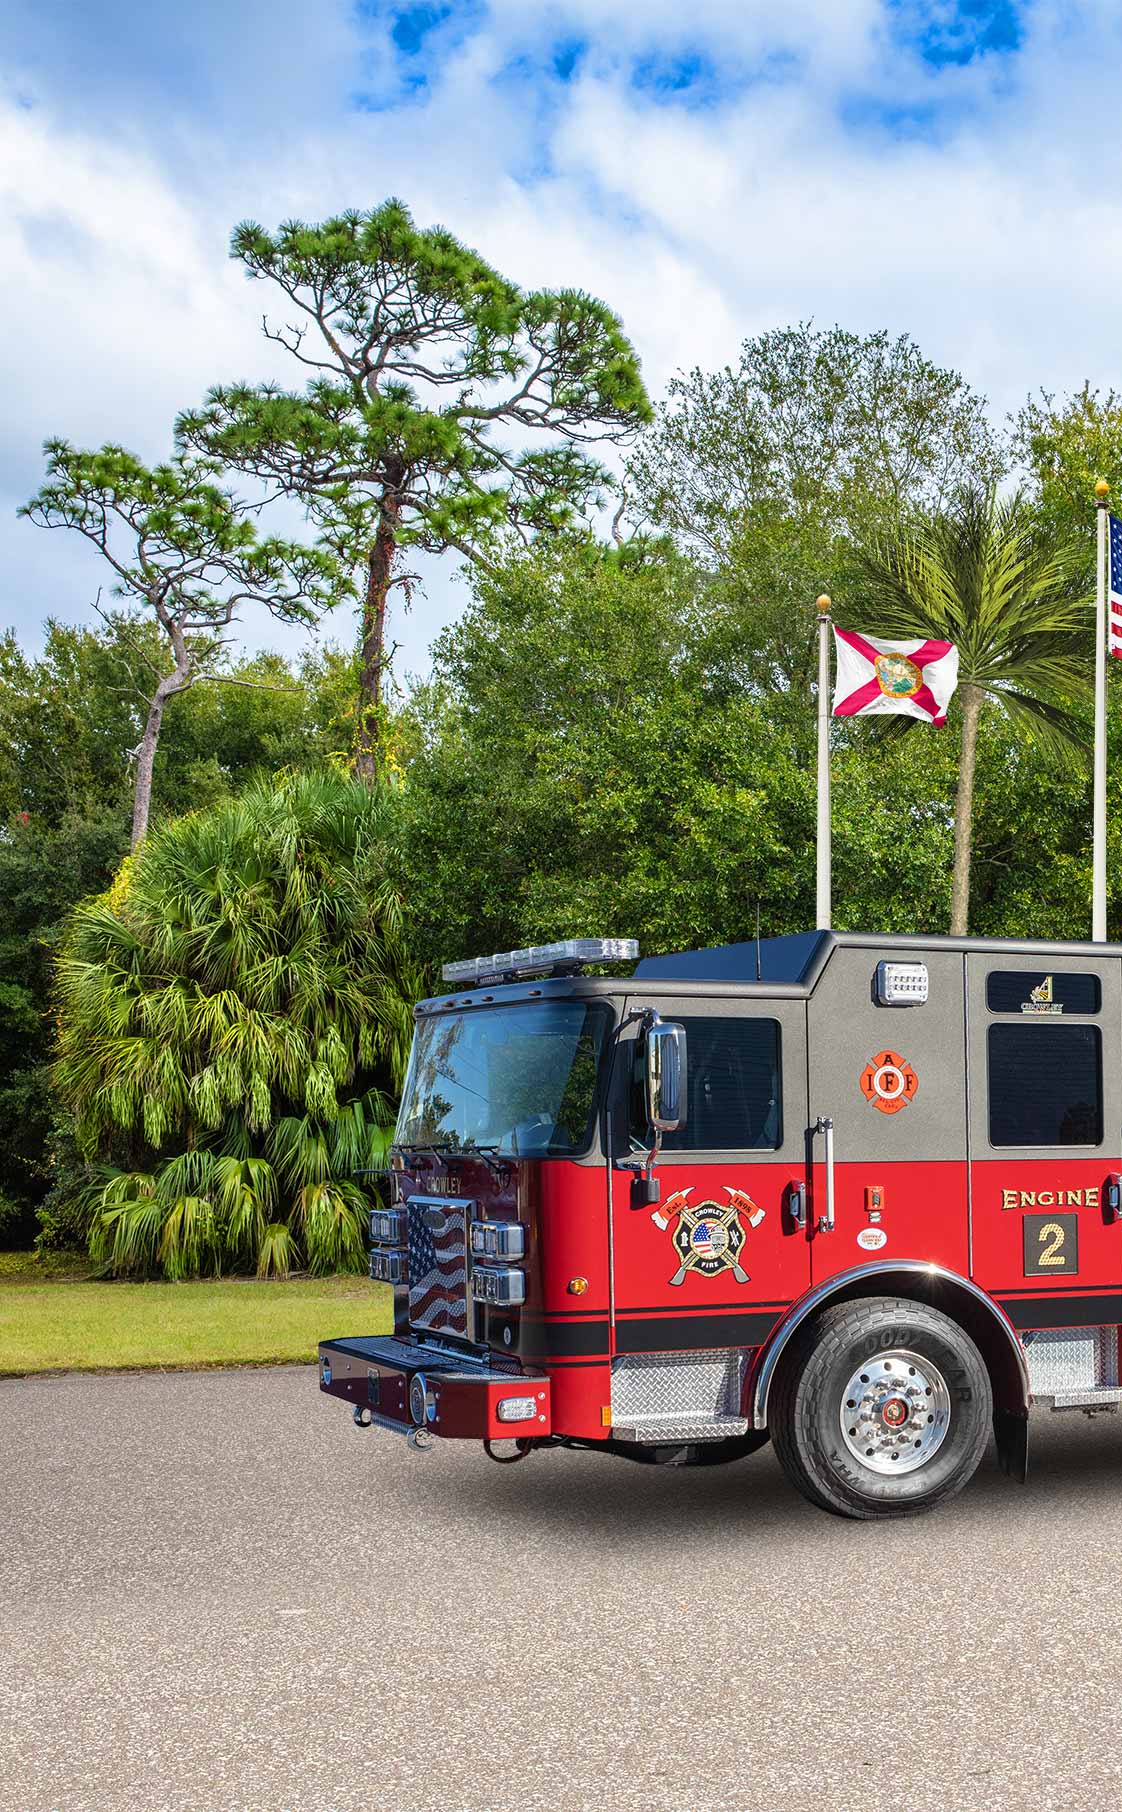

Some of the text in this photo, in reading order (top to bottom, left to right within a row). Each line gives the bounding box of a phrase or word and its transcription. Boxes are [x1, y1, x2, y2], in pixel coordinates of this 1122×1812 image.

[733, 1197, 752, 1214] 1898
[1001, 1187, 1099, 1211] ENGINE
[695, 1208, 725, 1217] CROWLEY
[1038, 1223, 1066, 1265] 2
